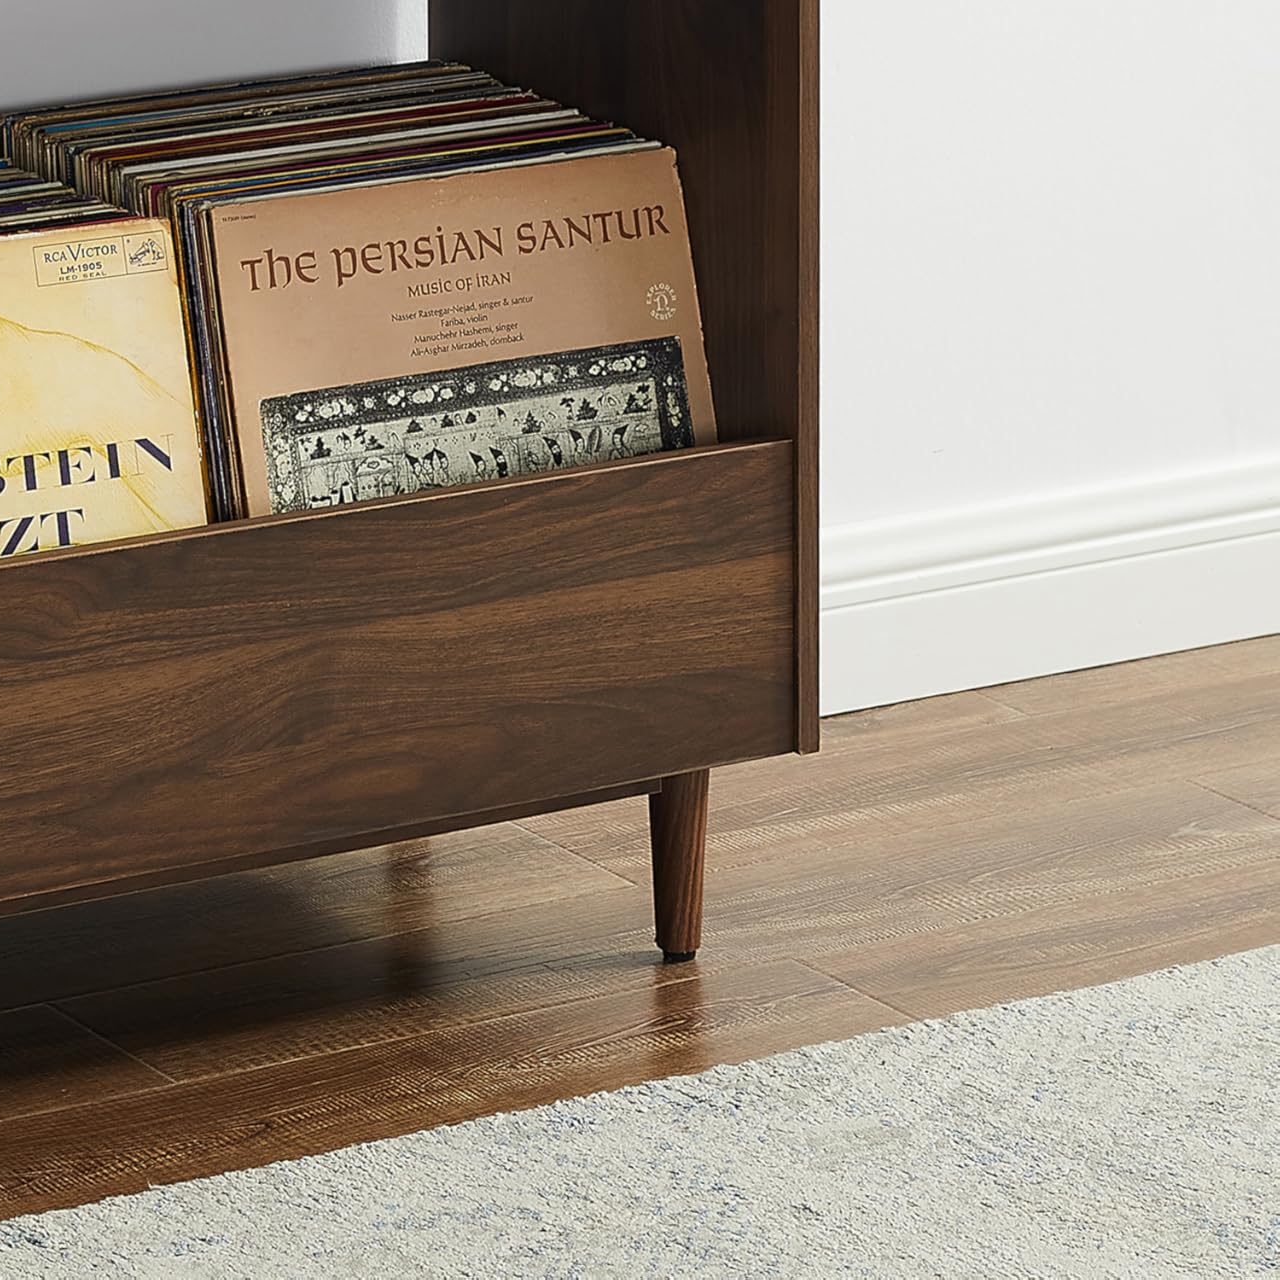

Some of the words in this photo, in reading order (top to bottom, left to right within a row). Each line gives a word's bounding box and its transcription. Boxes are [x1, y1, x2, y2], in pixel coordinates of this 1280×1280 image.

[517, 204, 671, 255] SANTUR
[43, 250, 68, 263] RCA
[60, 261, 103, 275] LM-1905
[83, 271, 107, 279] SEAL
[455, 277, 473, 292] OF
[391, 312, 417, 322] Nasser
[478, 299, 502, 311] singer
[502, 297, 510, 306] &
[511, 295, 534, 305] santur
[459, 322, 495, 337] Hashemi,
[495, 321, 519, 333] singer
